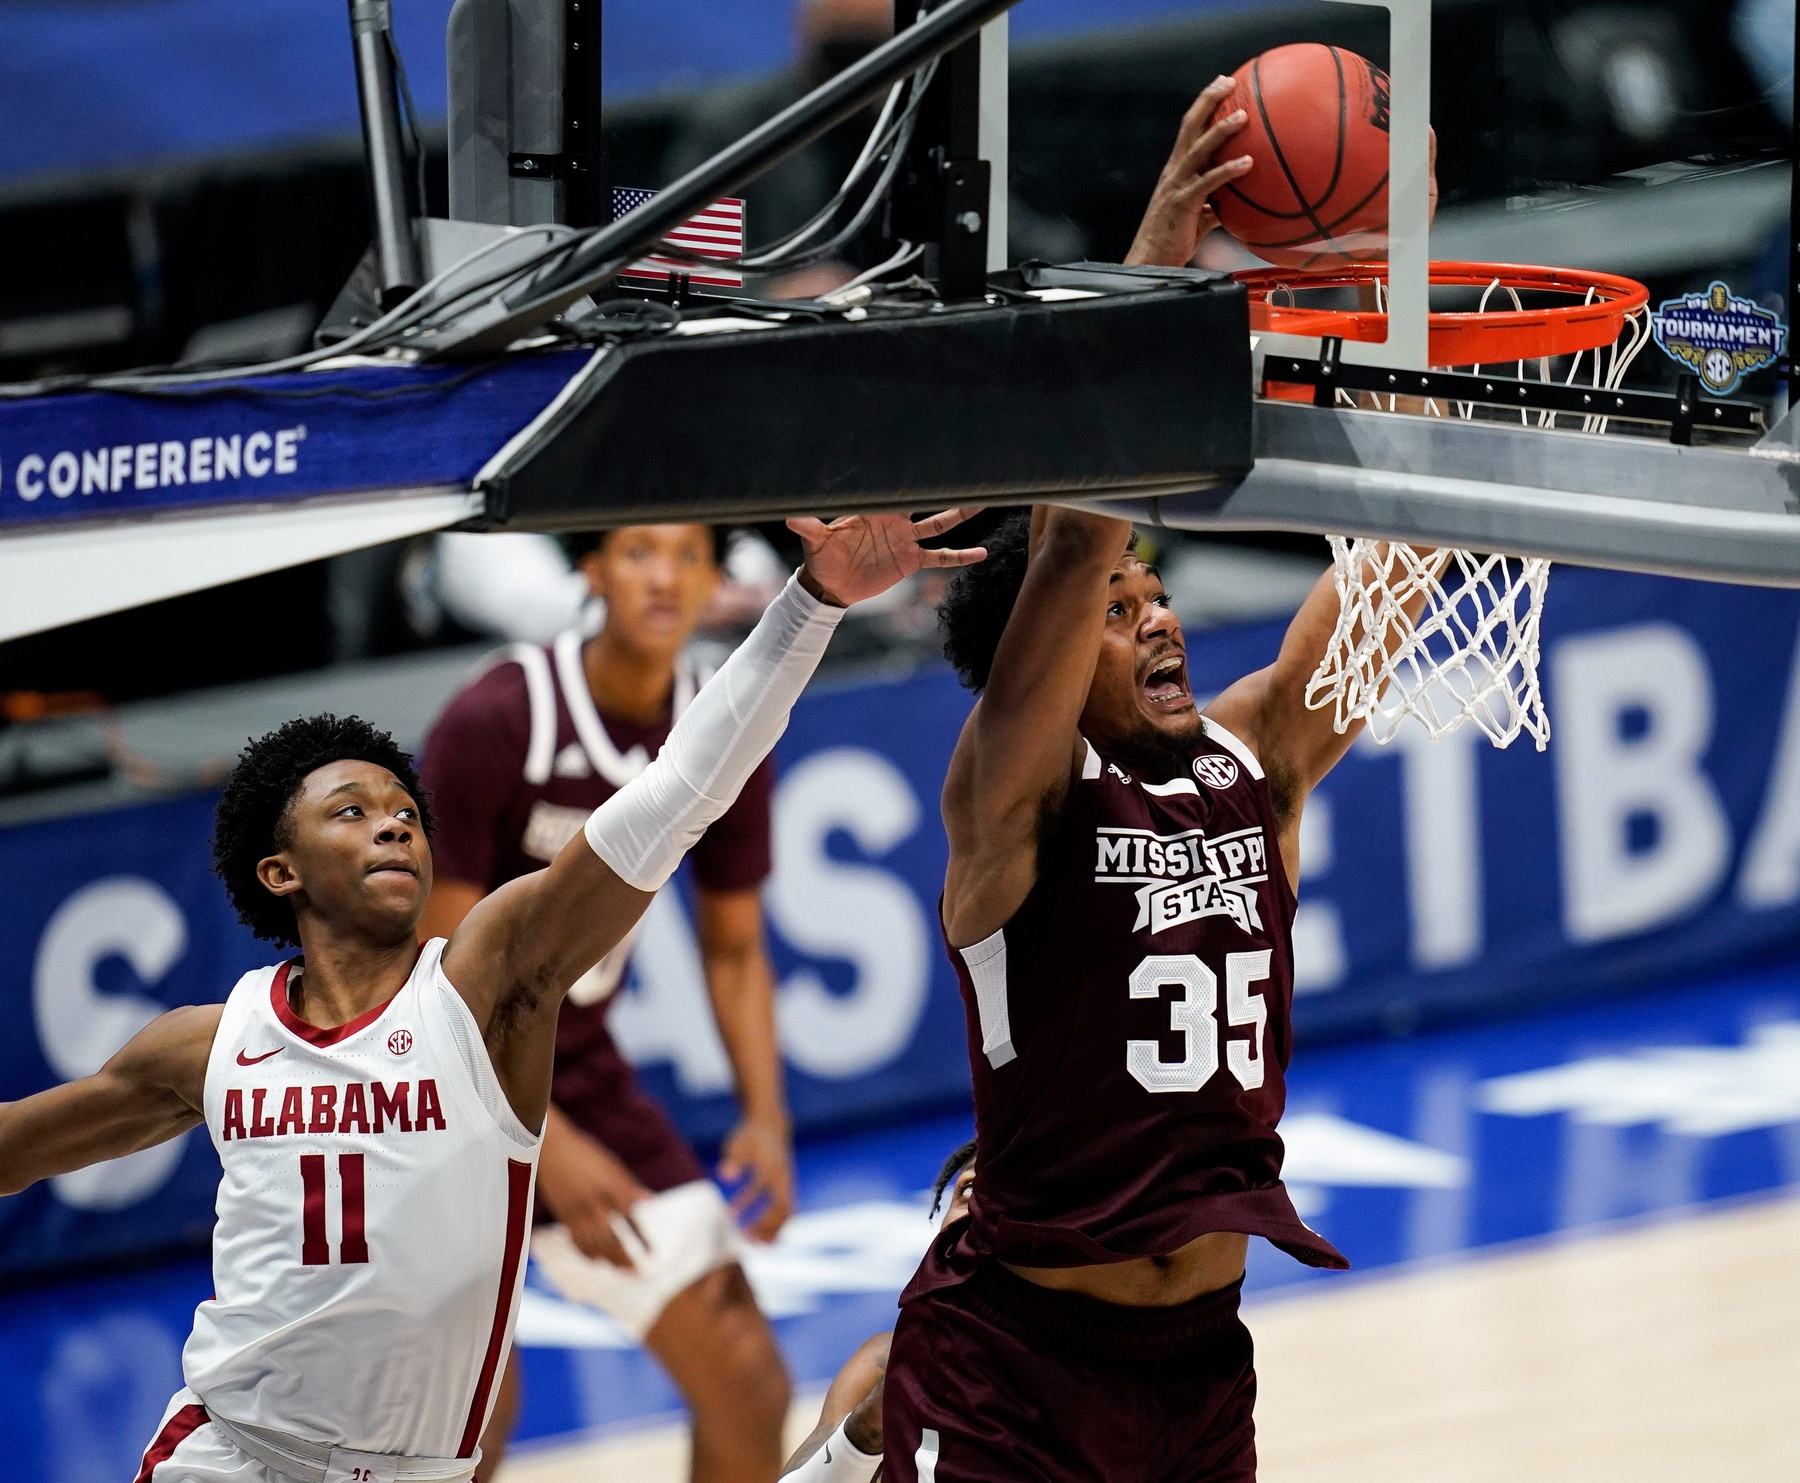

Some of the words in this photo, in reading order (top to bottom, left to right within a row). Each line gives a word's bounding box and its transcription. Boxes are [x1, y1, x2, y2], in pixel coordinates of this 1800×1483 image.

[1653, 317, 1784, 353] TOURNAMENT
[1705, 353, 1731, 384] SEC
[1196, 757, 1235, 787] SEC
[1126, 949, 1273, 1093] 35
[389, 1030, 412, 1054] SEC
[223, 1079, 447, 1141] ALABAMA
[300, 1153, 370, 1266] 11
